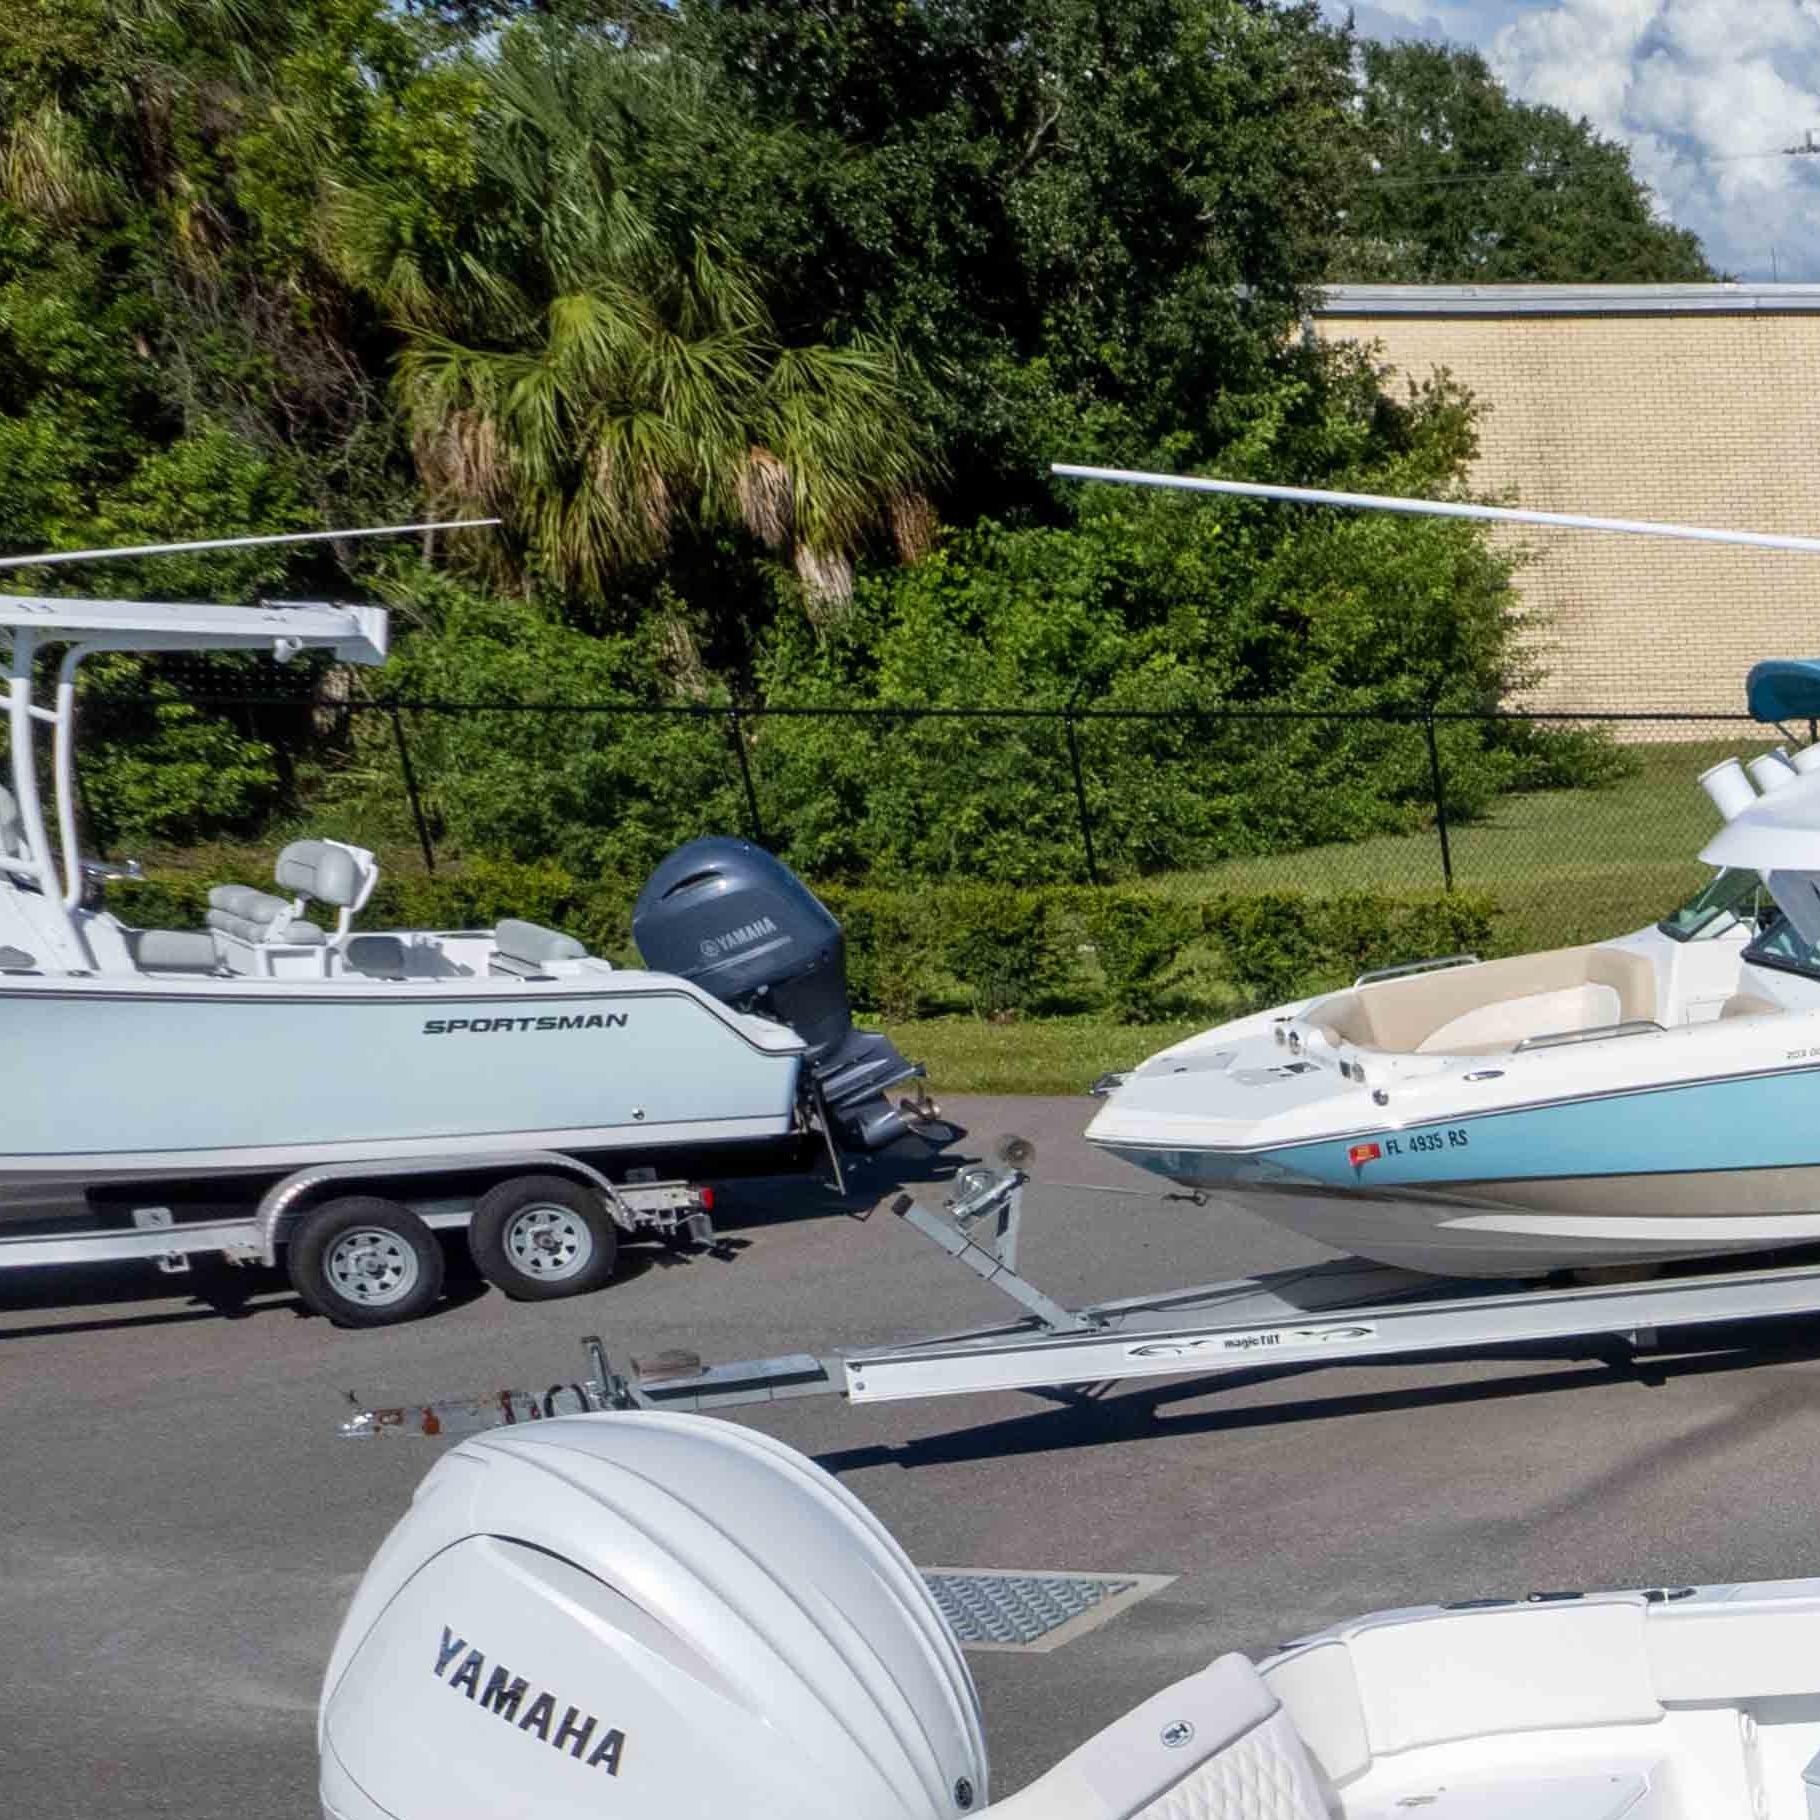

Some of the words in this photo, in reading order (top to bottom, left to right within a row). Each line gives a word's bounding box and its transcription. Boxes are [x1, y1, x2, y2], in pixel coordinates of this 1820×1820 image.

[716, 916, 778, 951] YAMAHA
[422, 1012, 629, 1035] SPORTSMAN
[1386, 1139, 1403, 1155] FL
[1447, 1128, 1469, 1147] RS
[433, 1624, 627, 1778] YAMAHA
